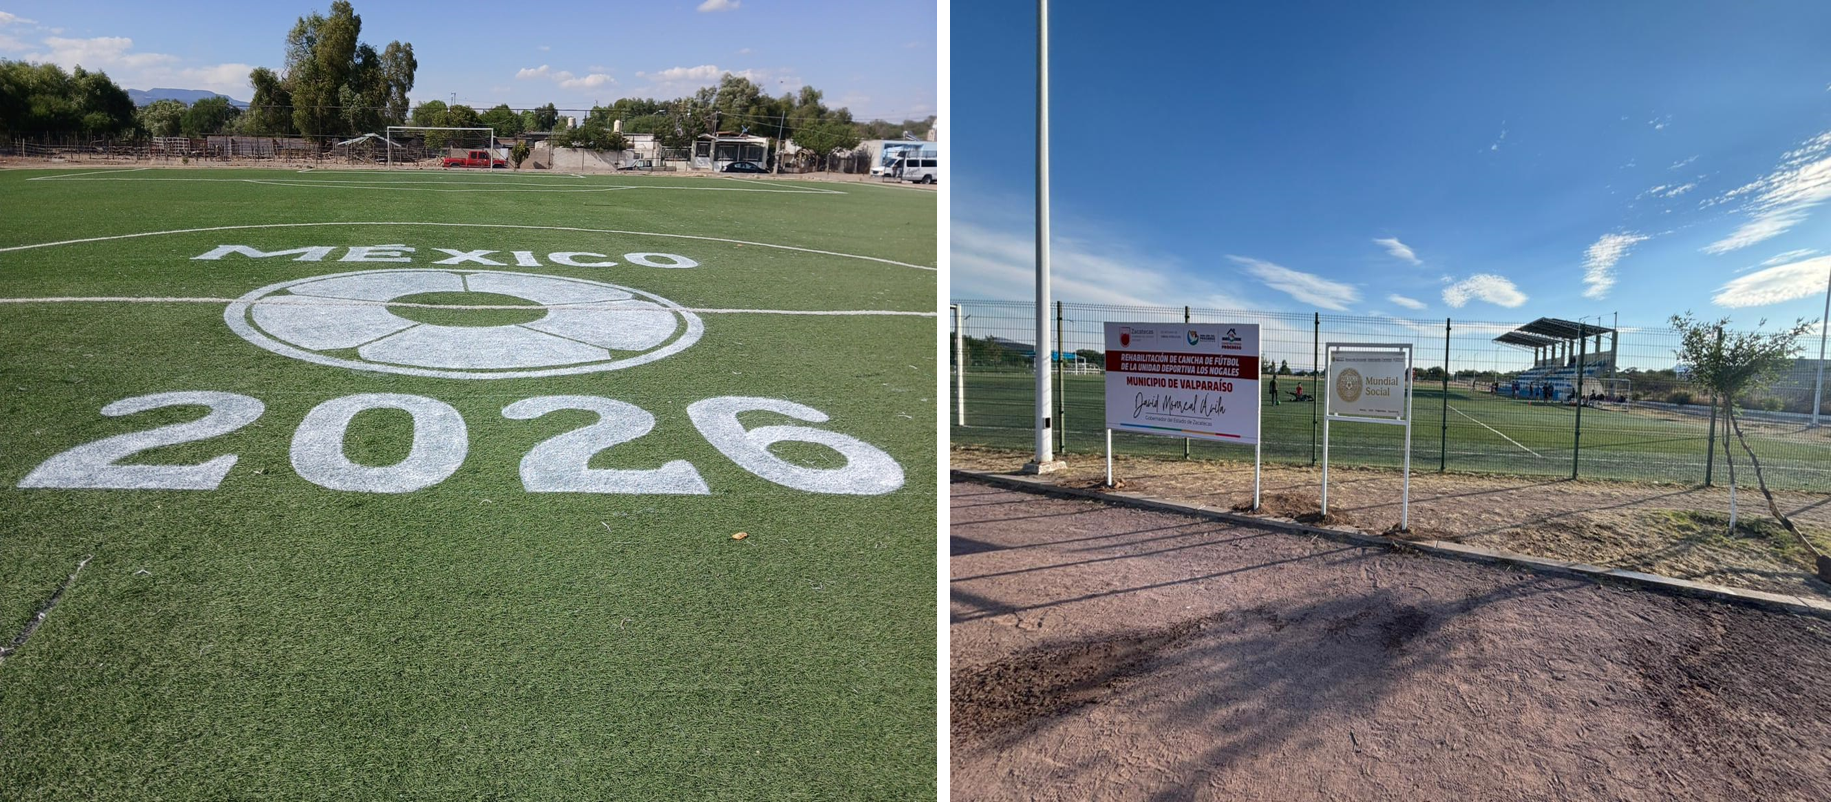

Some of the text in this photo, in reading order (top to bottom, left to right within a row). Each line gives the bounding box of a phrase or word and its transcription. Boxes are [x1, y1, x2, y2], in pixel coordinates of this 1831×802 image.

[1121, 353, 1168, 362] REHABILITACIÓN
[1178, 356, 1203, 364] CANCHA
[1205, 357, 1213, 365] DE
[1214, 355, 1239, 366] FÚTBOL
[1162, 365, 1195, 373] DEPORTIVA
[1197, 366, 1208, 374] LOS
[1209, 367, 1239, 376] NOGALES
[1127, 376, 1233, 392] MUNICIPIO DE VALPARAÍSO
[1366, 377, 1398, 385] Mundial
[1366, 388, 1389, 396] Social
[1133, 392, 1159, 418] David
[1163, 394, 1197, 416] Monreal
[16, 391, 905, 496] 2026
